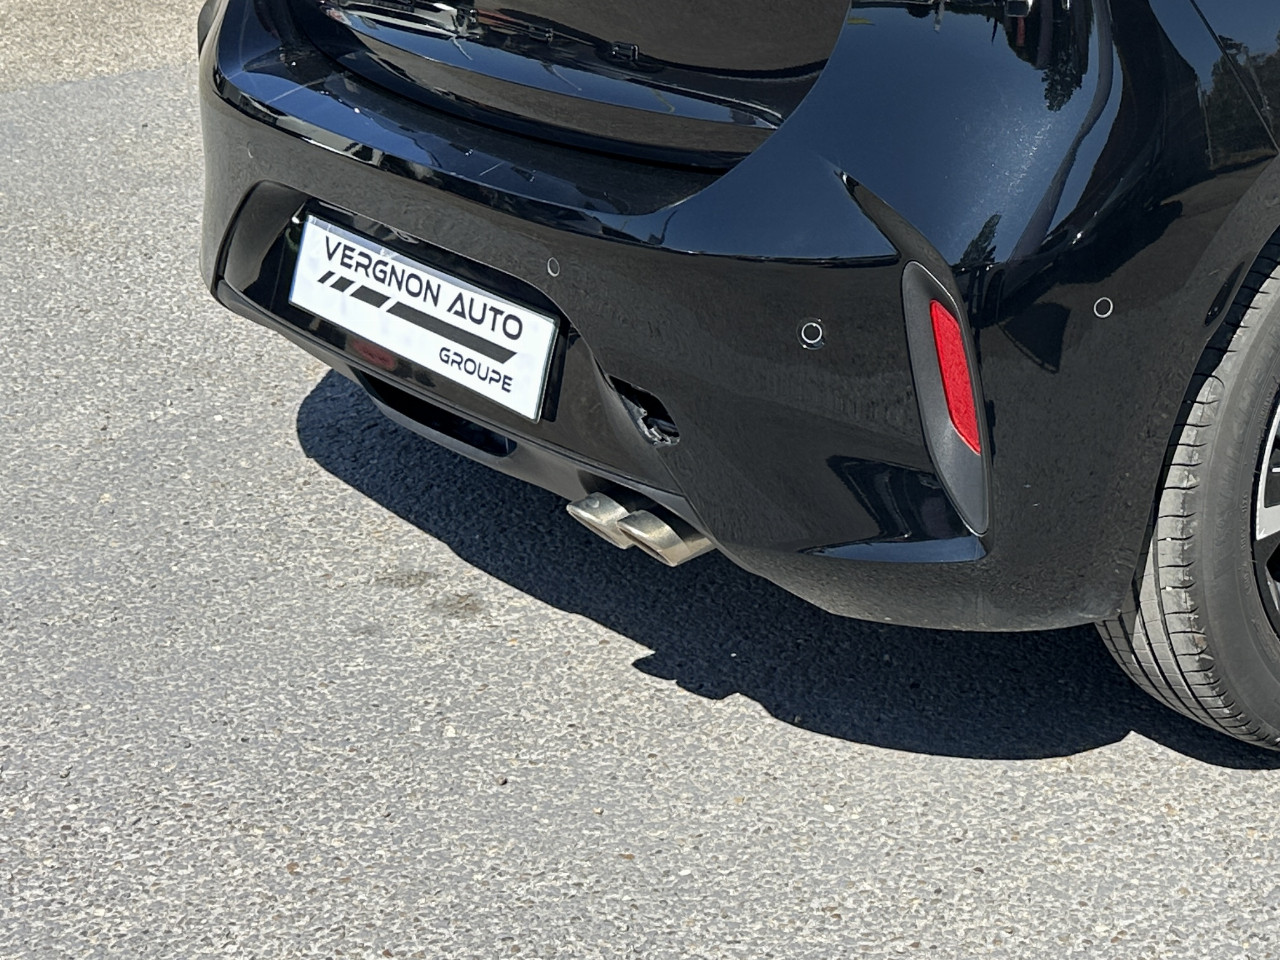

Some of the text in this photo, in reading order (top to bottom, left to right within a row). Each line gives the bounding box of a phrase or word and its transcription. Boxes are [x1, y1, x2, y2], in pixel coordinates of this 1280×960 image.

[325, 235, 523, 340] VERGNON AUTO
[439, 347, 514, 393] GROUPE
